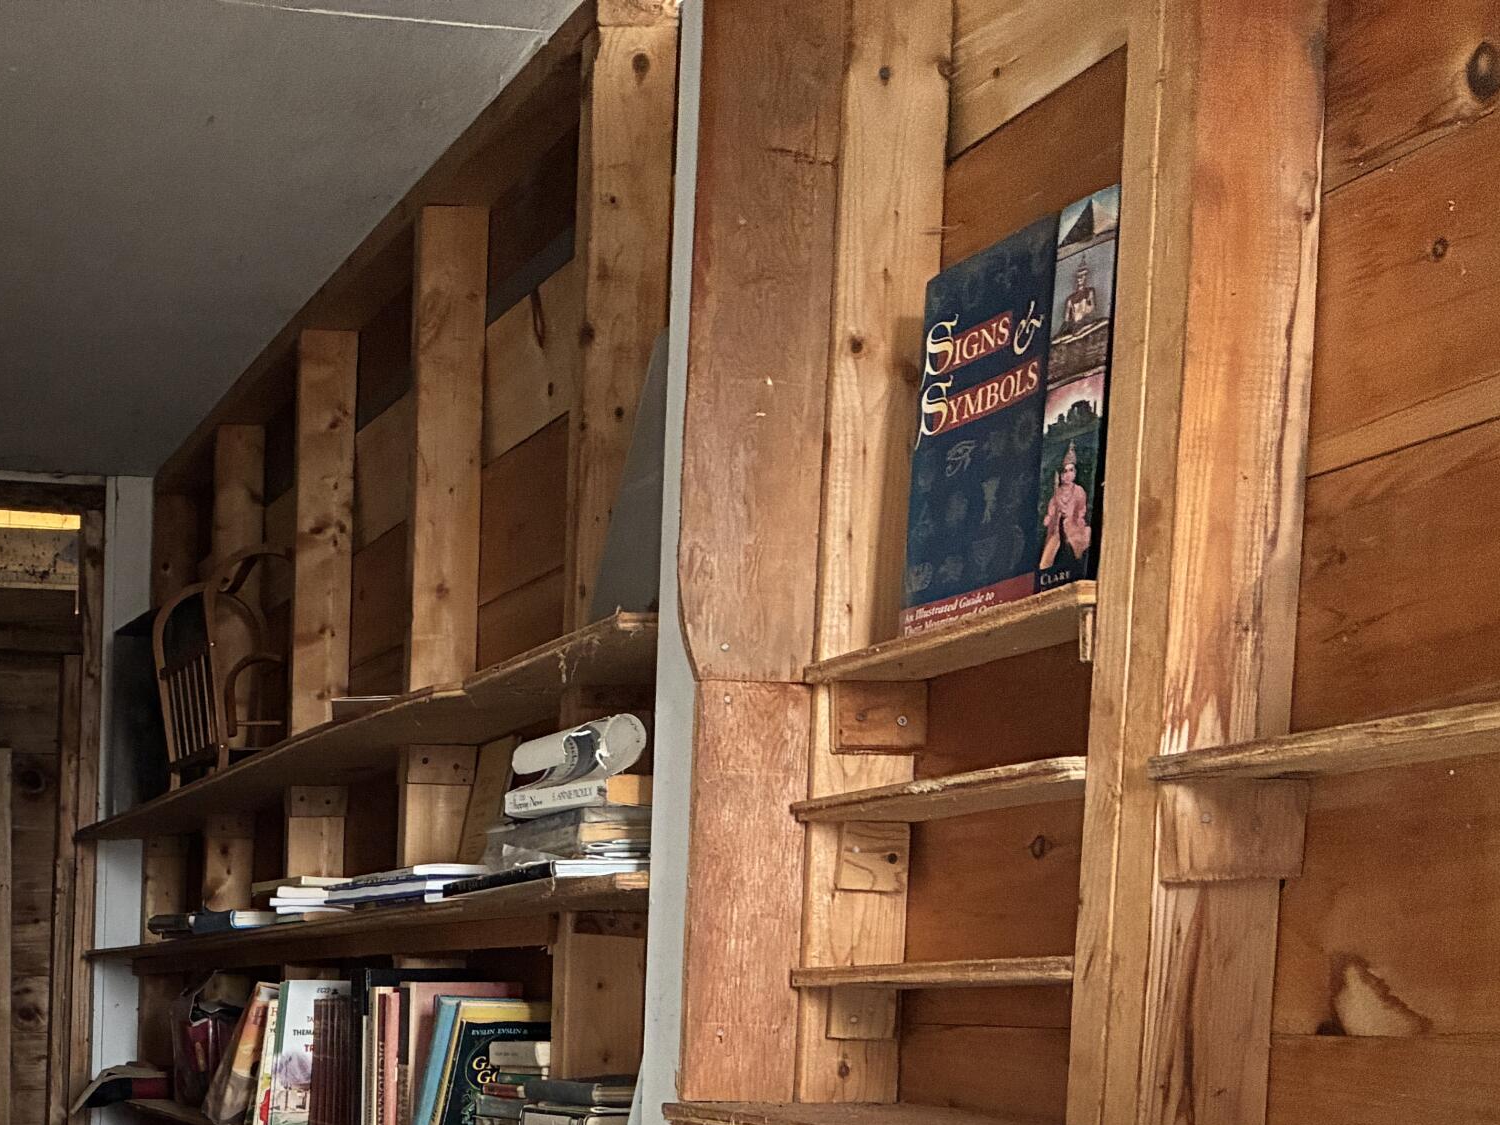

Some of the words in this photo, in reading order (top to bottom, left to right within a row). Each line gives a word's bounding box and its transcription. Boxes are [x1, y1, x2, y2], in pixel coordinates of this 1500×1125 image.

[1013, 300, 1045, 356] &
[914, 360, 1039, 451] SYMBOLS
[915, 599, 959, 621] Illustrated
[959, 595, 985, 612] Guide
[985, 591, 995, 602] to
